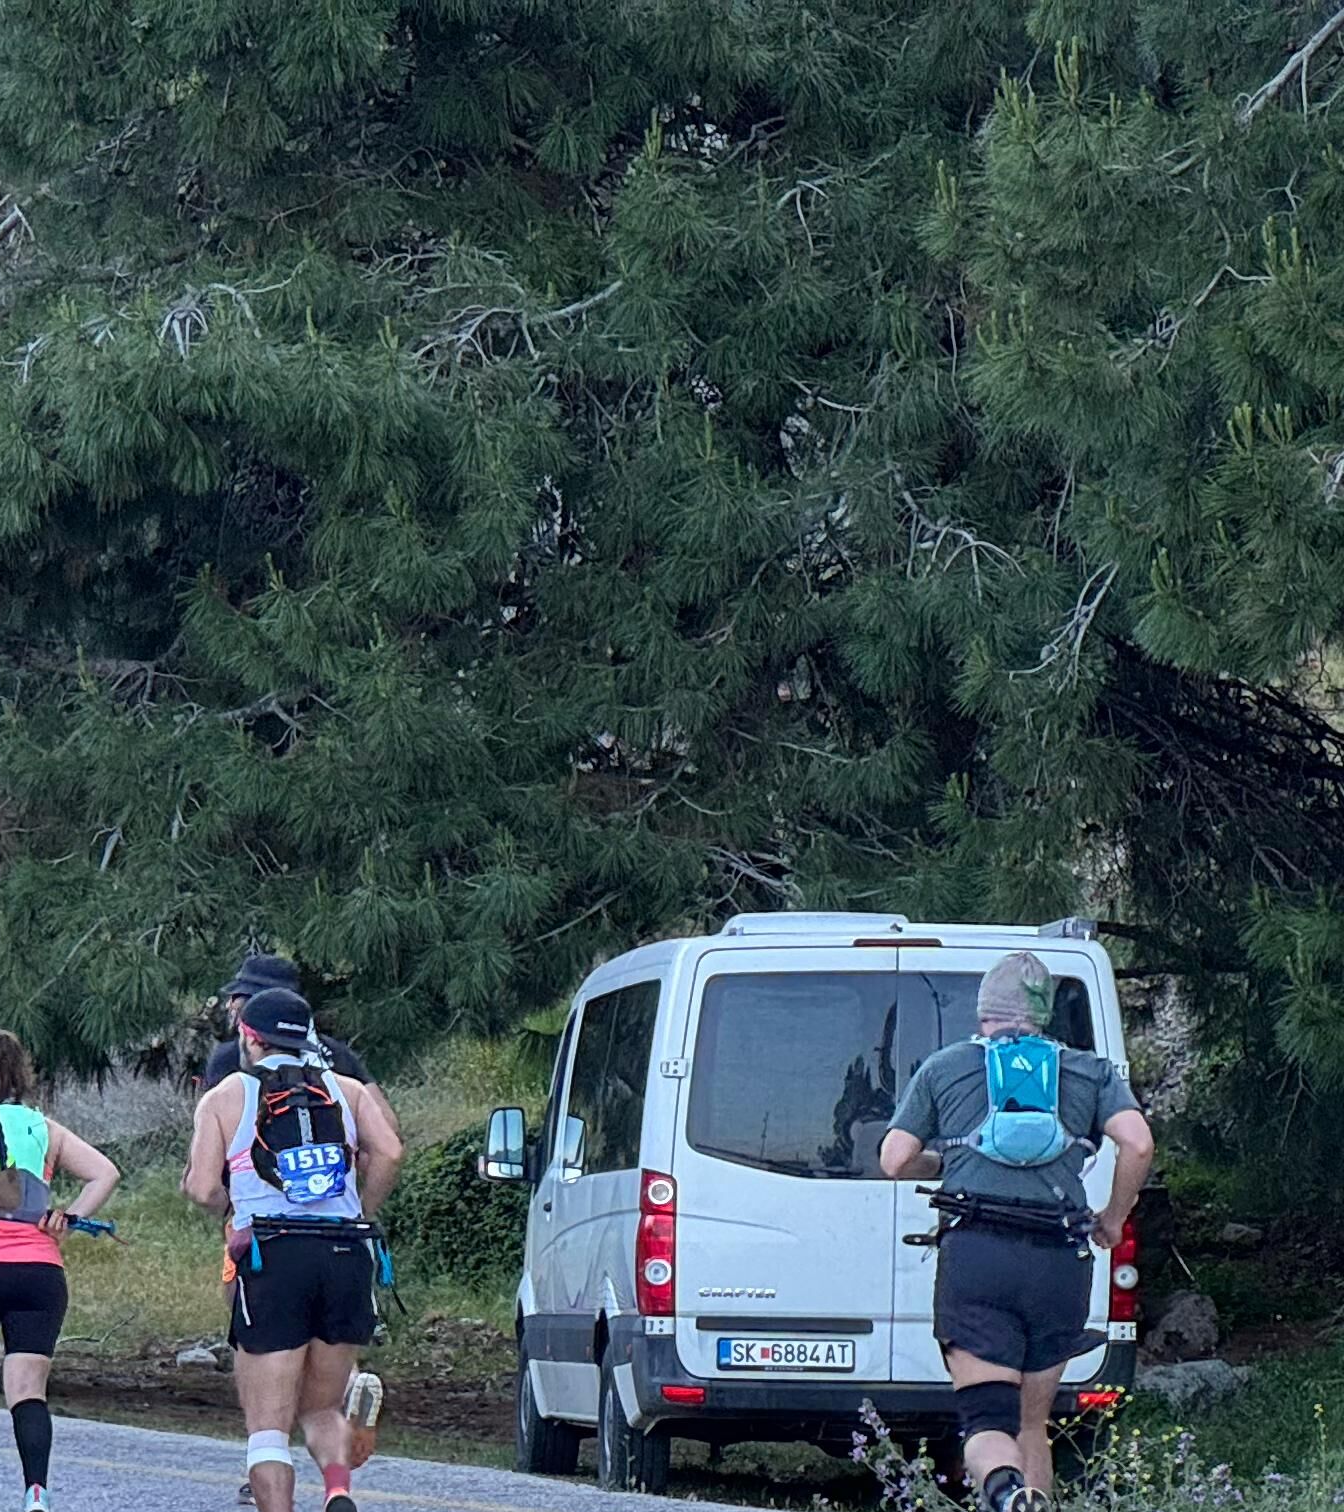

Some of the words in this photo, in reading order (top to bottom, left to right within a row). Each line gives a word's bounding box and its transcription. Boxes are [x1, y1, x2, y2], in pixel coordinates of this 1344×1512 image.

[284, 1146, 340, 1171] 1513
[698, 1287, 777, 1299] CRAFTER
[733, 1343, 757, 1363] SK
[771, 1343, 820, 1363] 6884
[825, 1344, 849, 1364] AT
